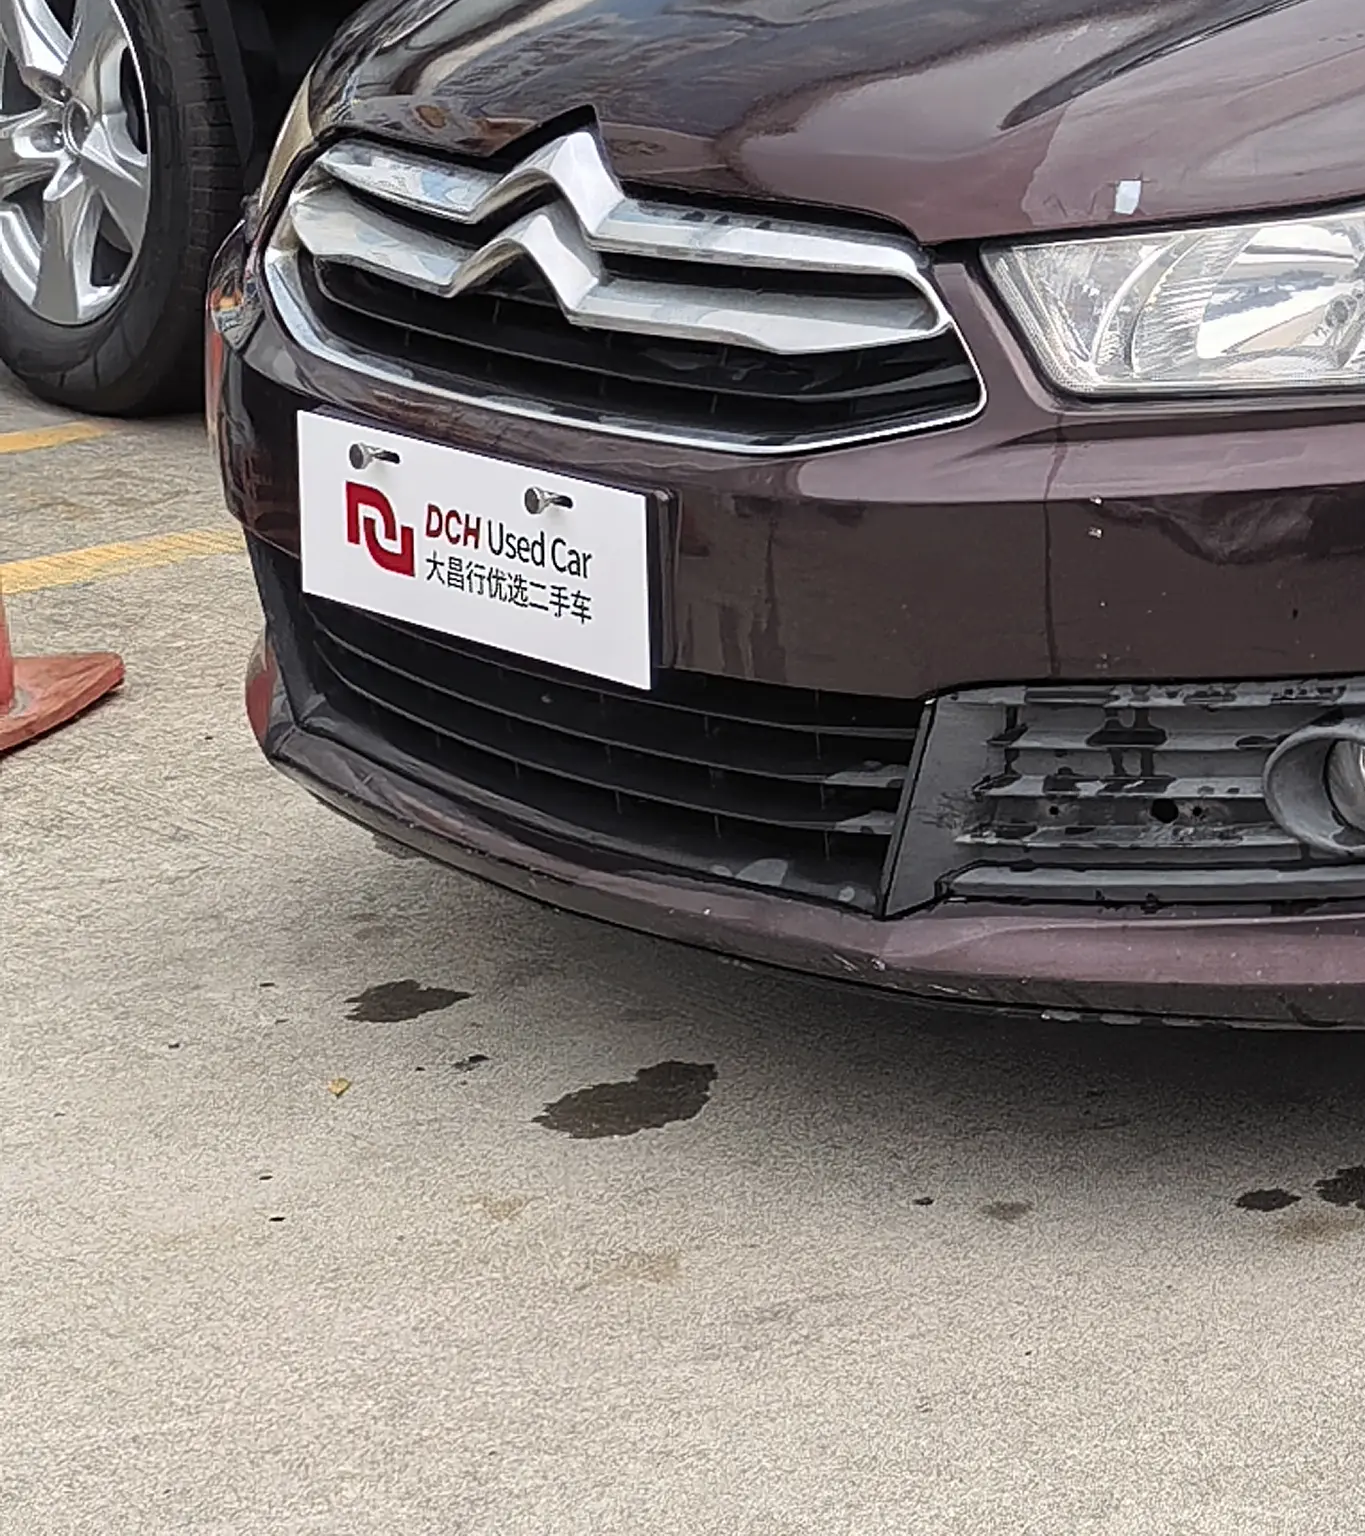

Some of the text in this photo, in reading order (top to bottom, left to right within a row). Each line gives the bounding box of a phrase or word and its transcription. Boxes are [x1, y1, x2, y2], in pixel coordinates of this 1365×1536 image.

[425, 503, 593, 579] DCH Used Car
[425, 549, 593, 625] 大昌行优选二手车
